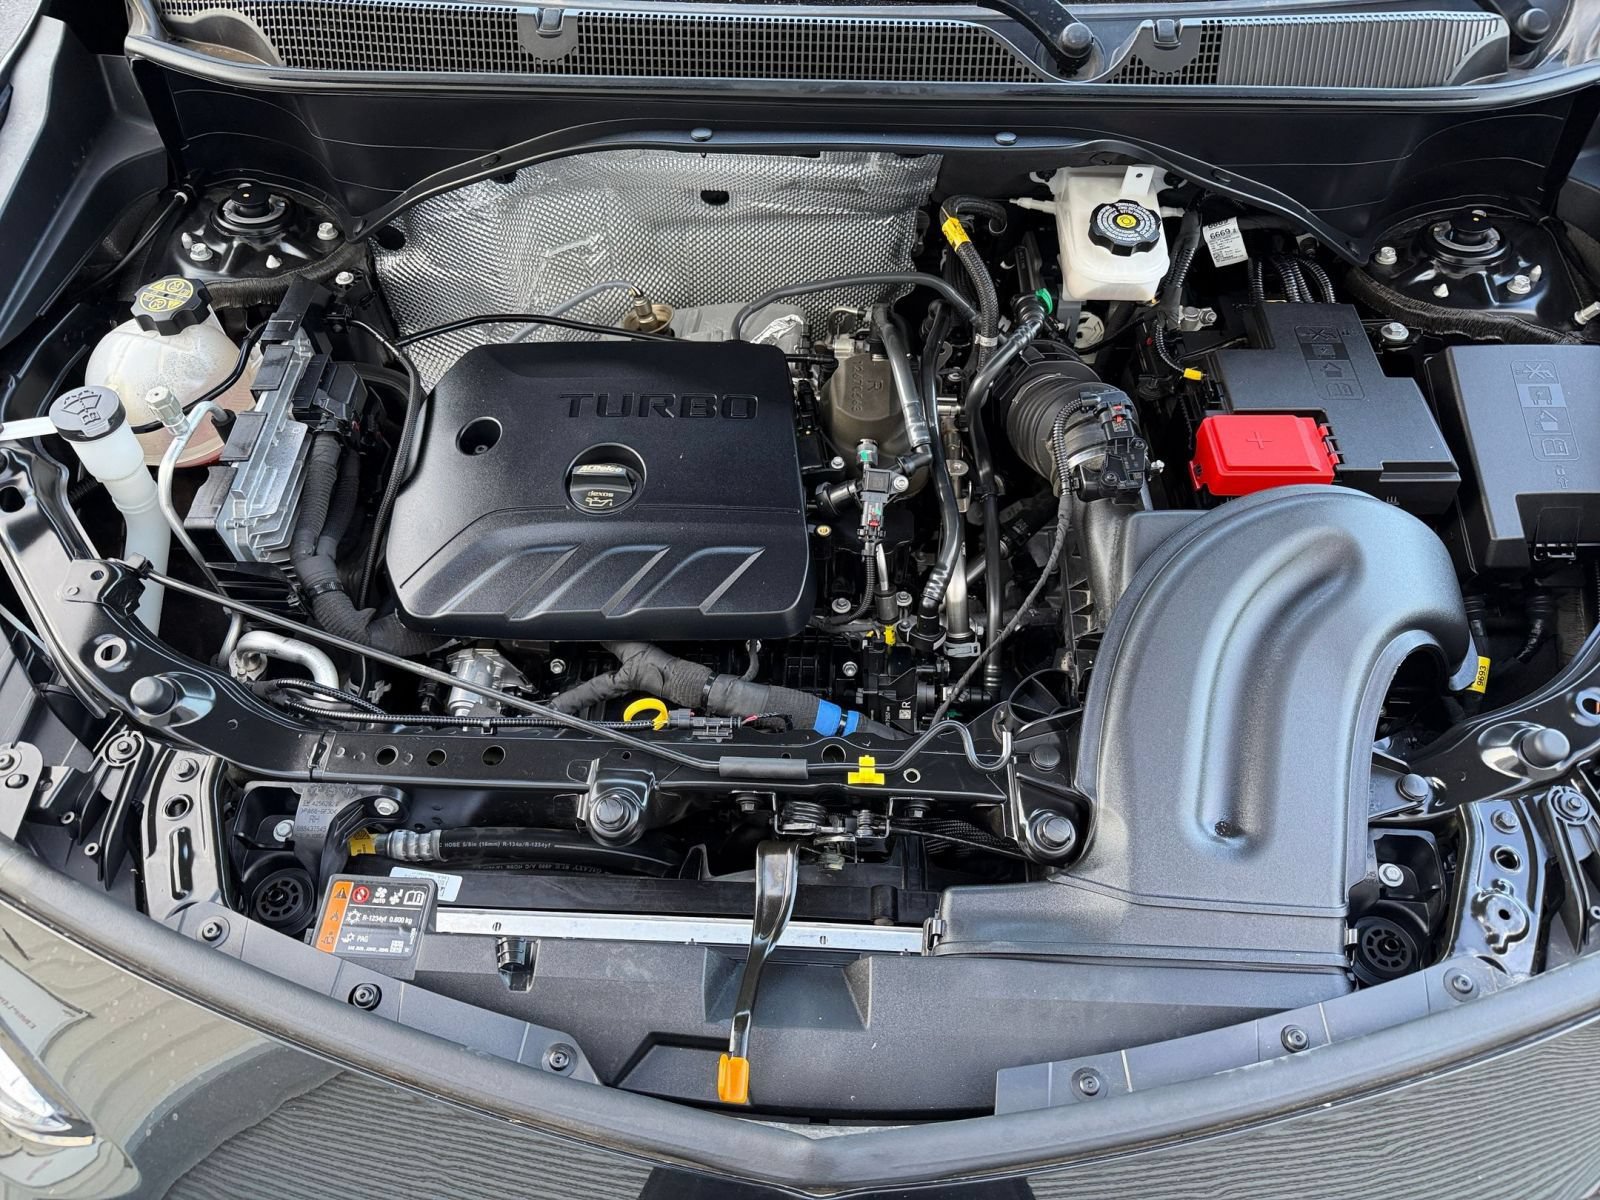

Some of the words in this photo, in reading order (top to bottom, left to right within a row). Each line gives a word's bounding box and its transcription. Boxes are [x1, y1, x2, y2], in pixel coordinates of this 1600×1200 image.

[1210, 228, 1231, 239] 6669
[867, 380, 884, 392] R
[559, 392, 759, 420] TURBO
[577, 464, 624, 474] ACDelco
[587, 490, 614, 498] dexos
[1476, 665, 1487, 687] 9693
[901, 701, 911, 709] R
[361, 914, 387, 923] R-1234yf
[405, 916, 413, 925] kg
[356, 935, 369, 943] PAG
